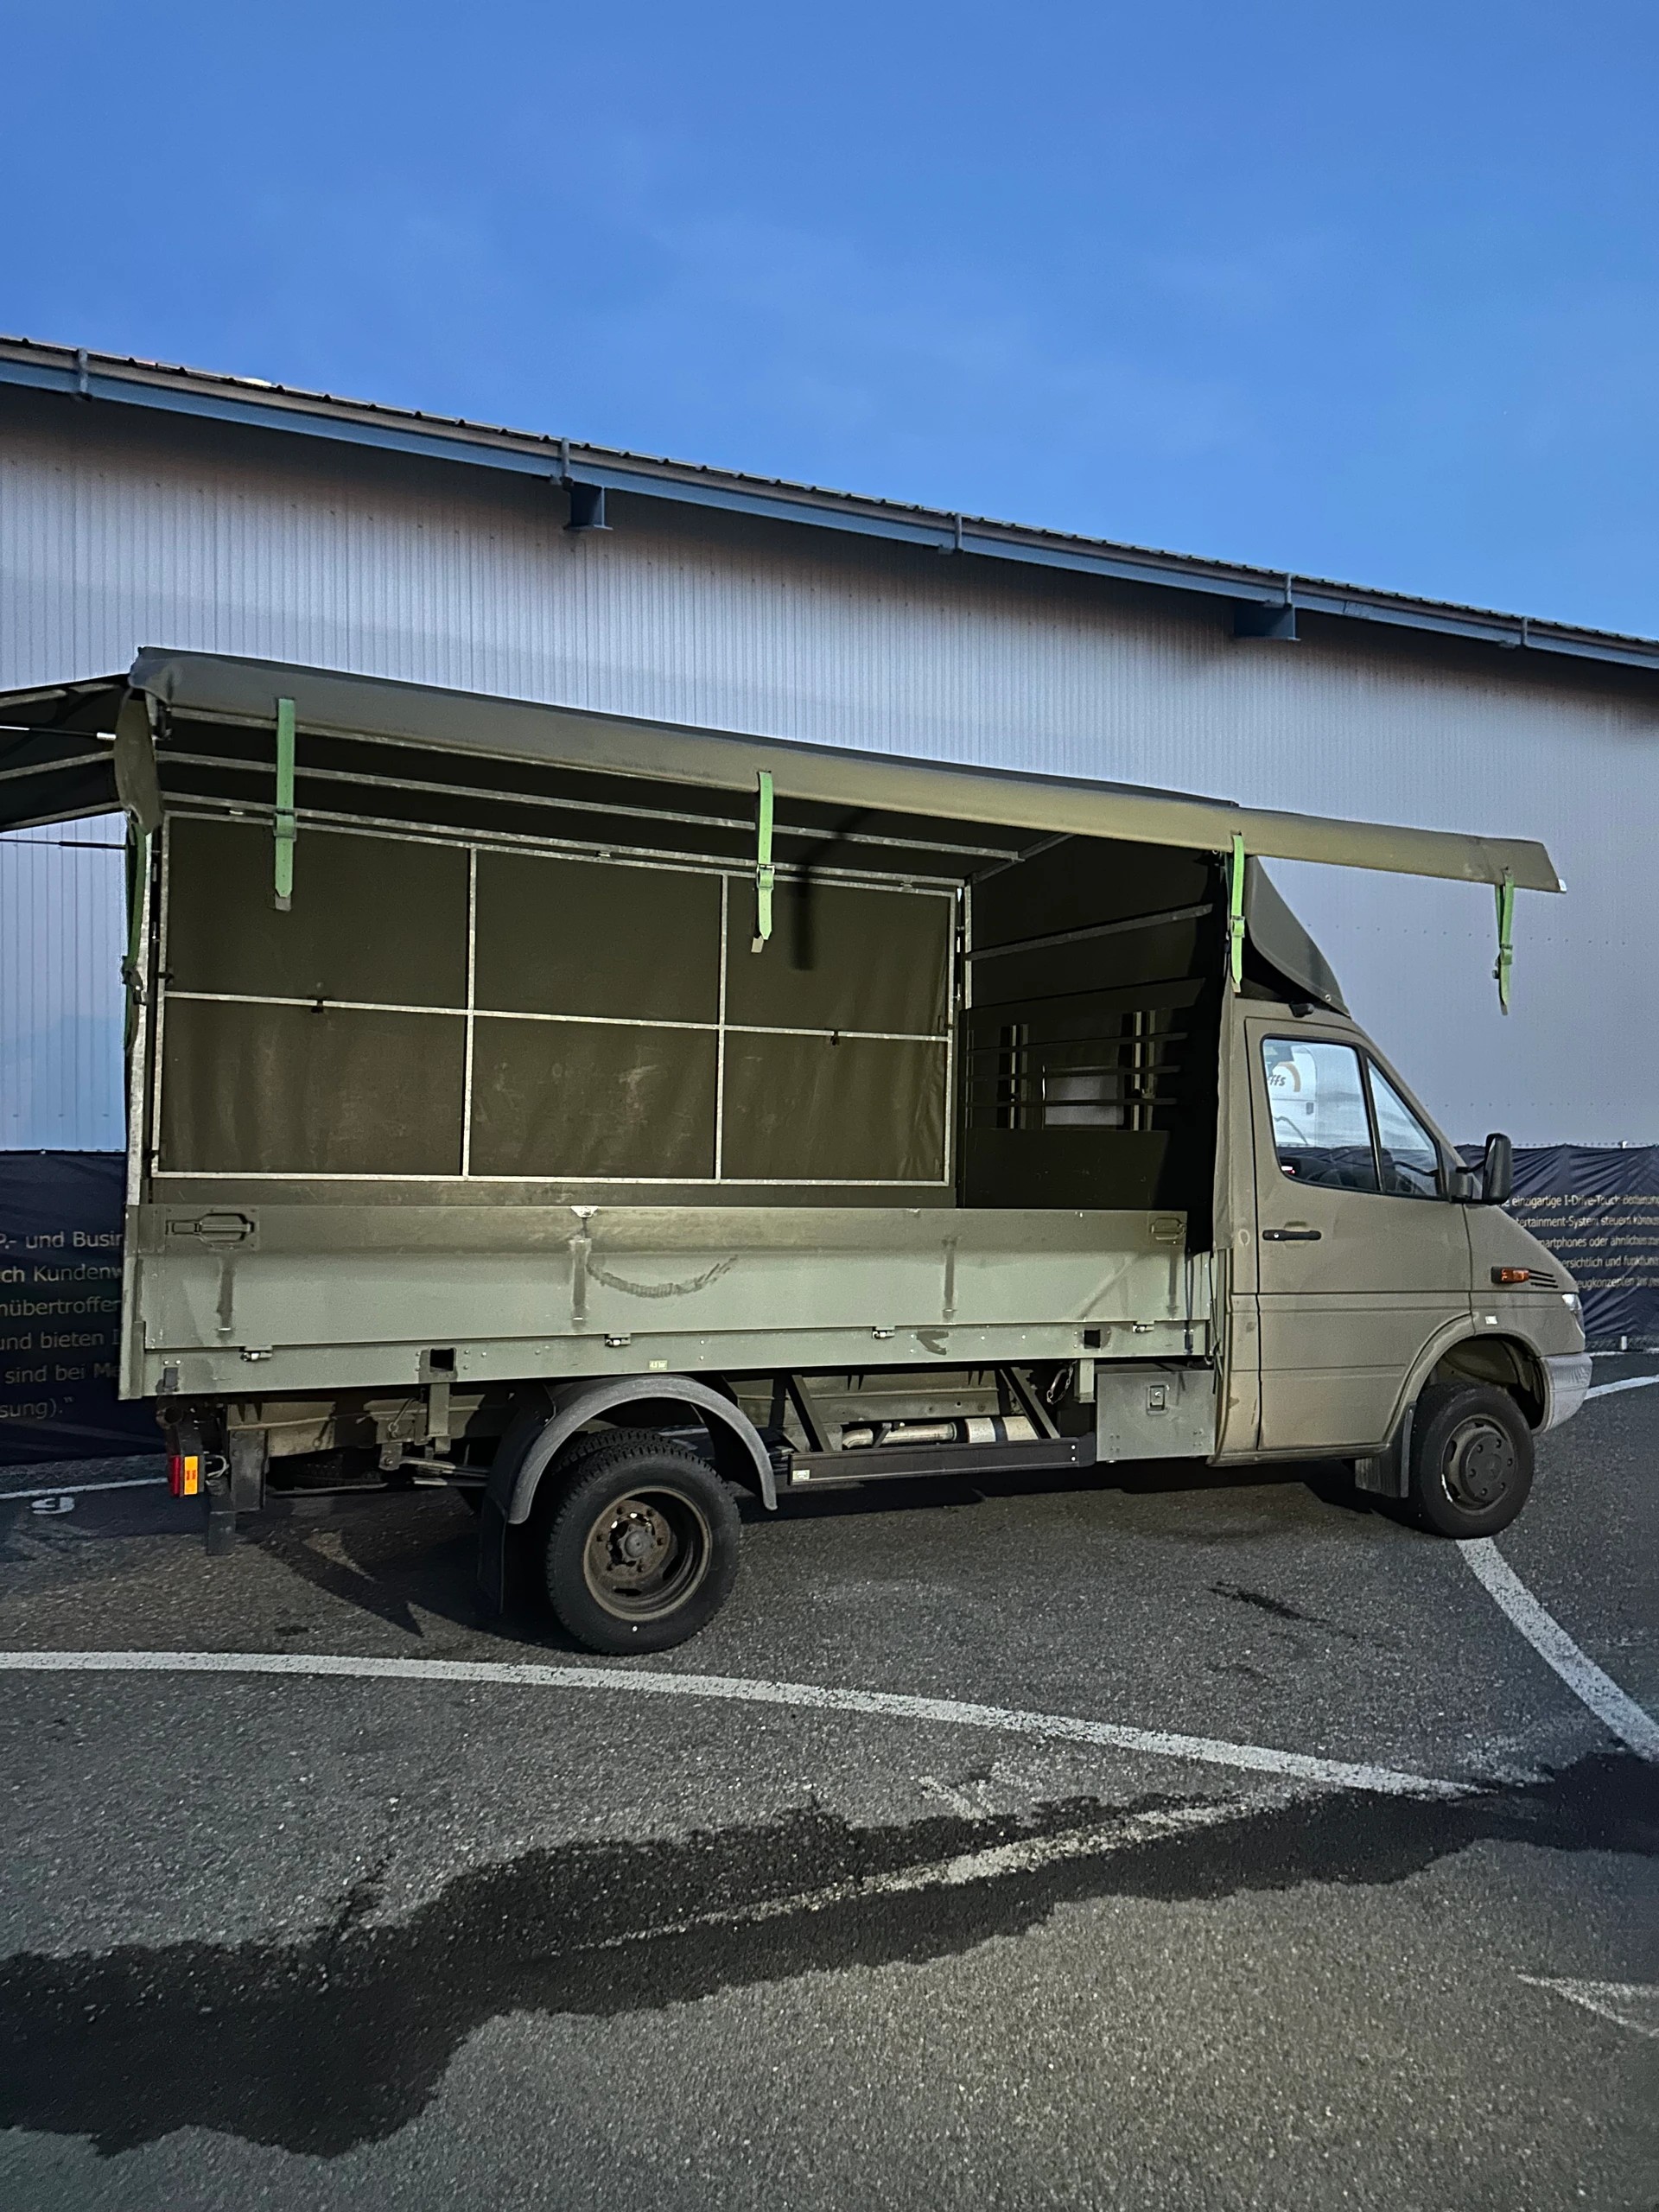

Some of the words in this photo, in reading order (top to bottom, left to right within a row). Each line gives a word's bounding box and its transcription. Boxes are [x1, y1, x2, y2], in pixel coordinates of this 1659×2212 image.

[1511, 1195, 1562, 1209] einzigartige
[26, 1230, 64, 1249] und
[1589, 1236, 1608, 1247] oder
[1605, 1255, 1621, 1267] und
[40, 1331, 105, 1349] bieten
[4, 1364, 48, 1384] sind
[55, 1363, 85, 1382] bei
